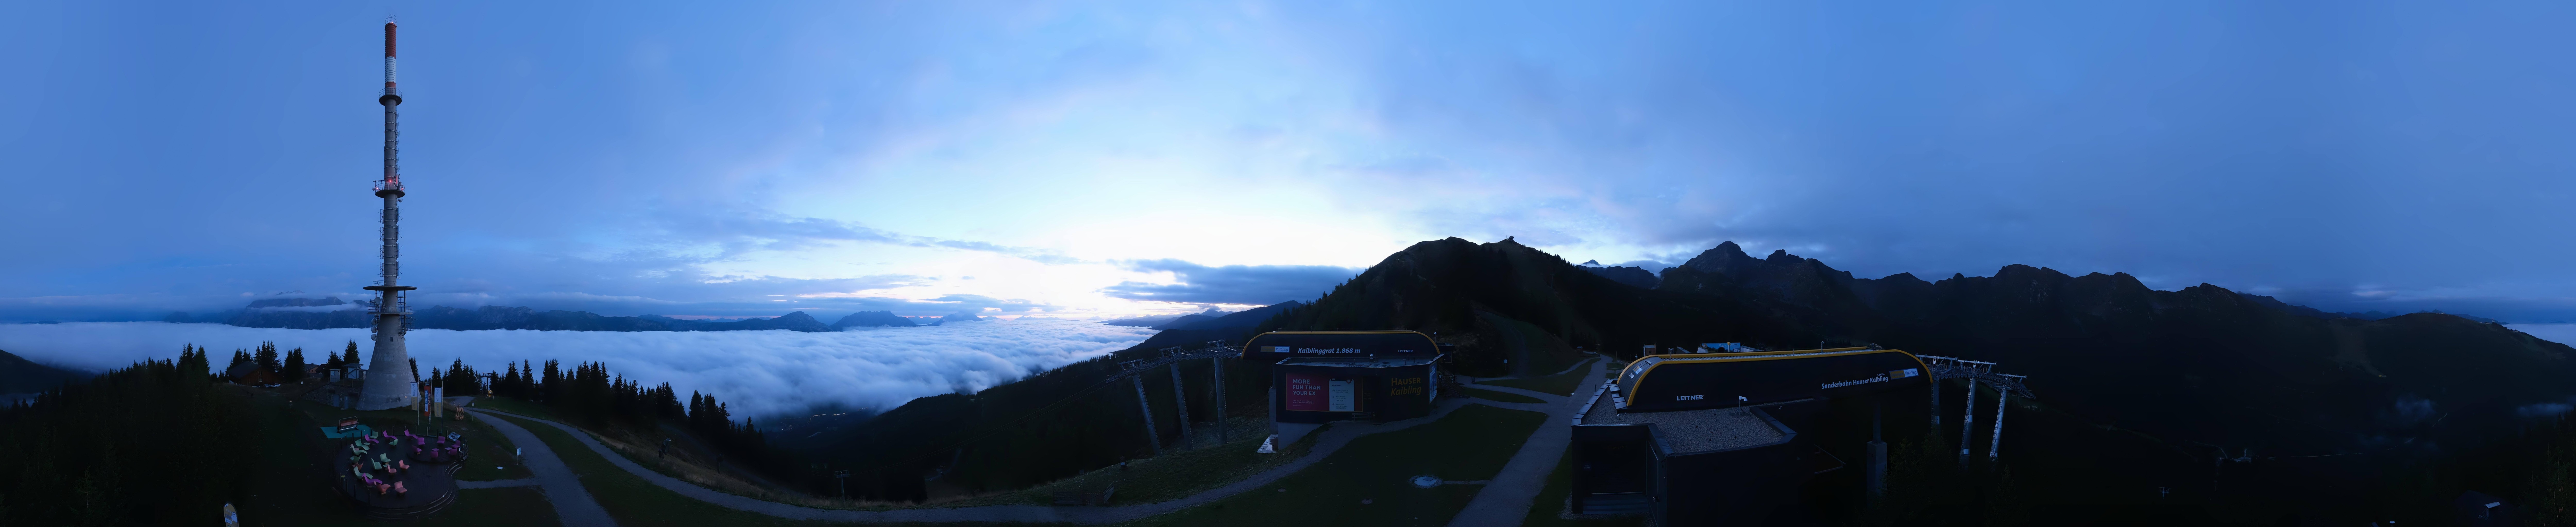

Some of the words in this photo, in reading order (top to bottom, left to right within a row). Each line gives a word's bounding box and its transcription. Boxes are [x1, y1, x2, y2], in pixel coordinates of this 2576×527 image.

[1391, 377, 1421, 386] HAUSER
[1822, 380, 1852, 389] Senderbahn
[1391, 386, 1421, 396] Kaibling
